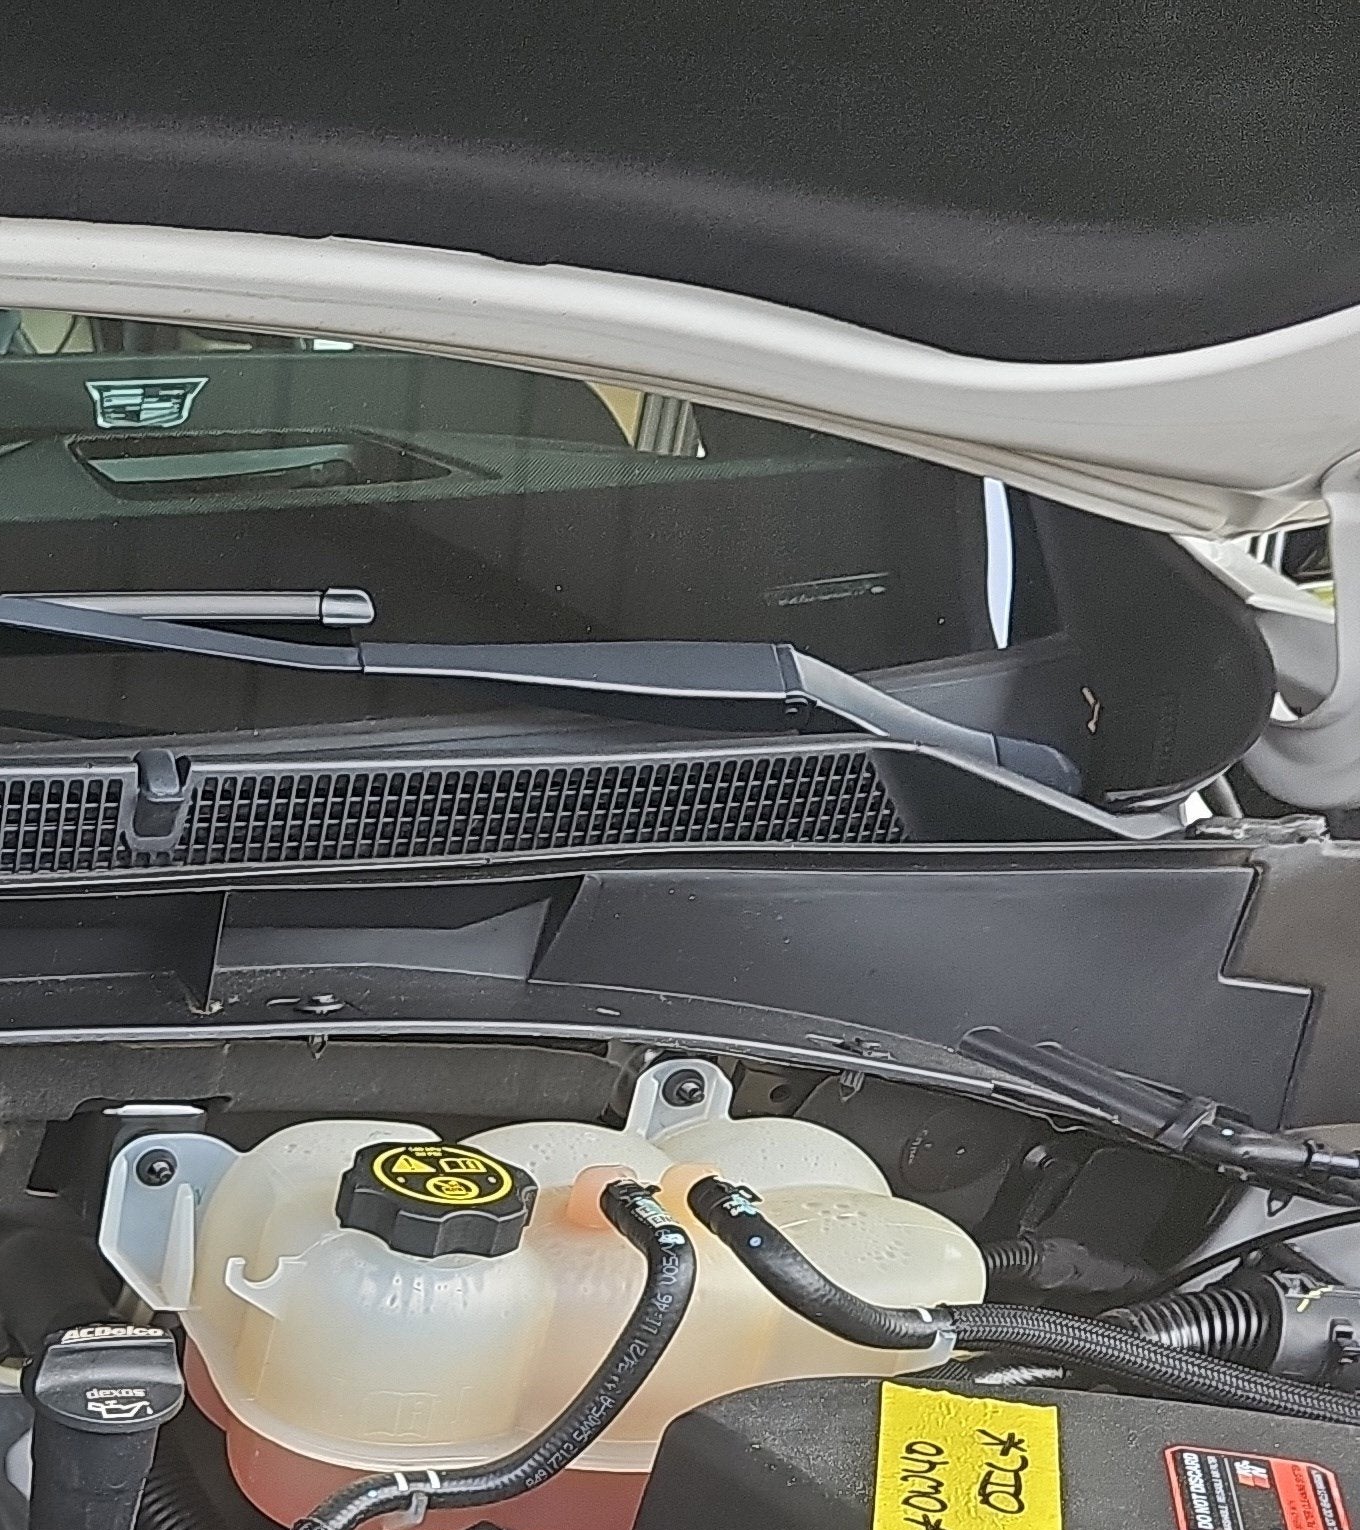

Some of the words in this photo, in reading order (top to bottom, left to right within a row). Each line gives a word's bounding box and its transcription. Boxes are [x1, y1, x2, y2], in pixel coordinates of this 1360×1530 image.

[60, 1325, 165, 1345] ACDelco
[85, 1387, 146, 1400] dexos
[1182, 1452, 1206, 1494] DISCARD
[1191, 1493, 1211, 1515] NOT
[1195, 1514, 1214, 1530] DO
